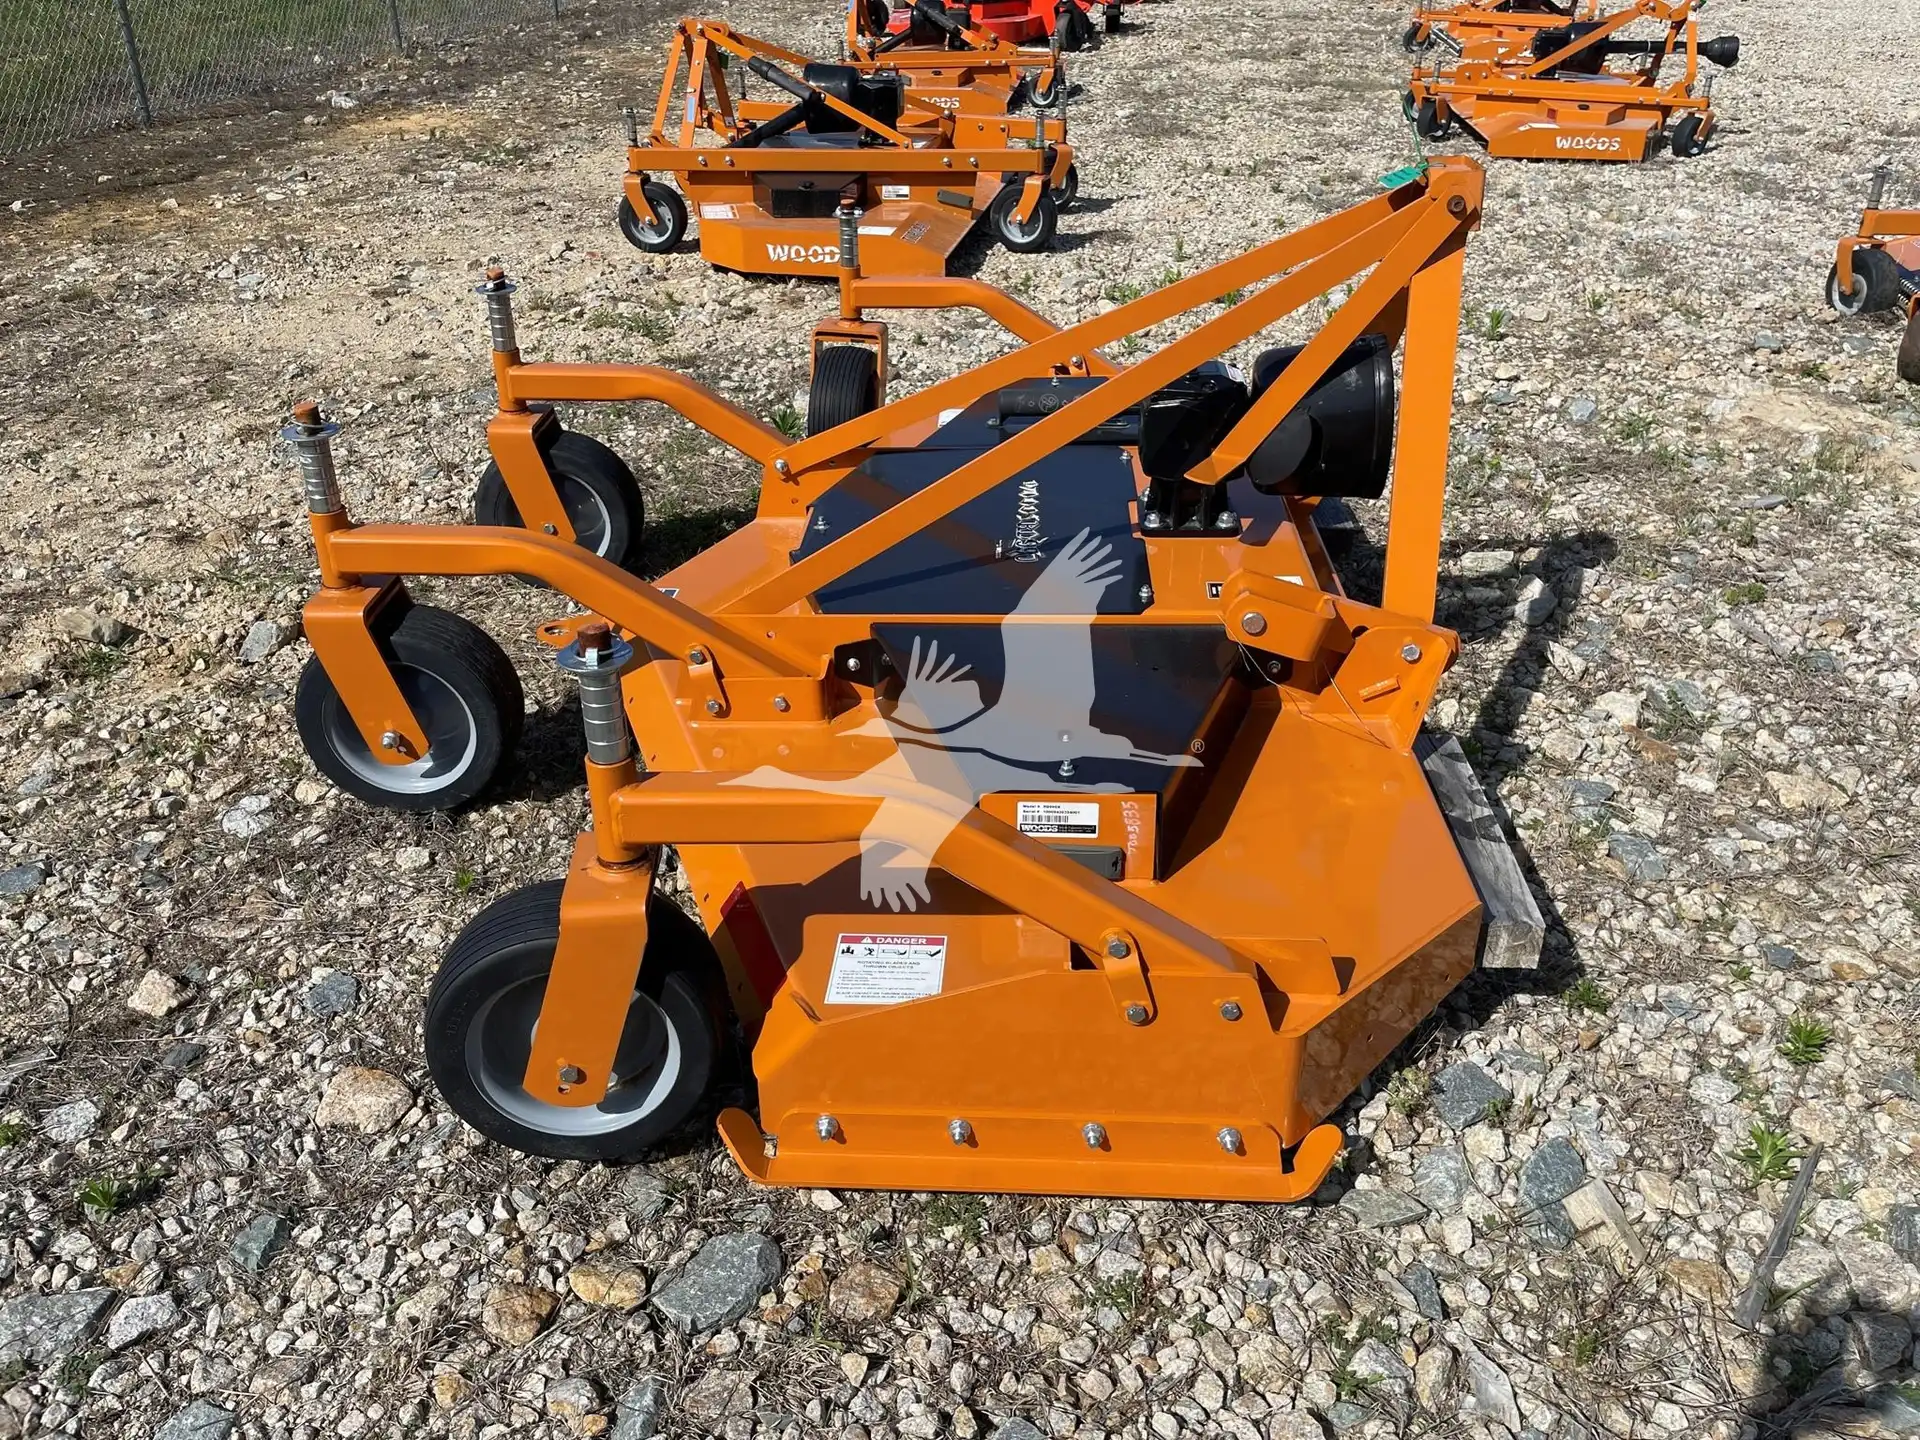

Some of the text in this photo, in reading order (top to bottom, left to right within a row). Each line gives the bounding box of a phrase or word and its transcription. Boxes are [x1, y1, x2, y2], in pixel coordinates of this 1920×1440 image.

[1555, 136, 1621, 151] WOODS
[766, 243, 841, 263] WOOD
[1021, 824, 1059, 832] WOODS
[876, 937, 928, 945] DANGER
